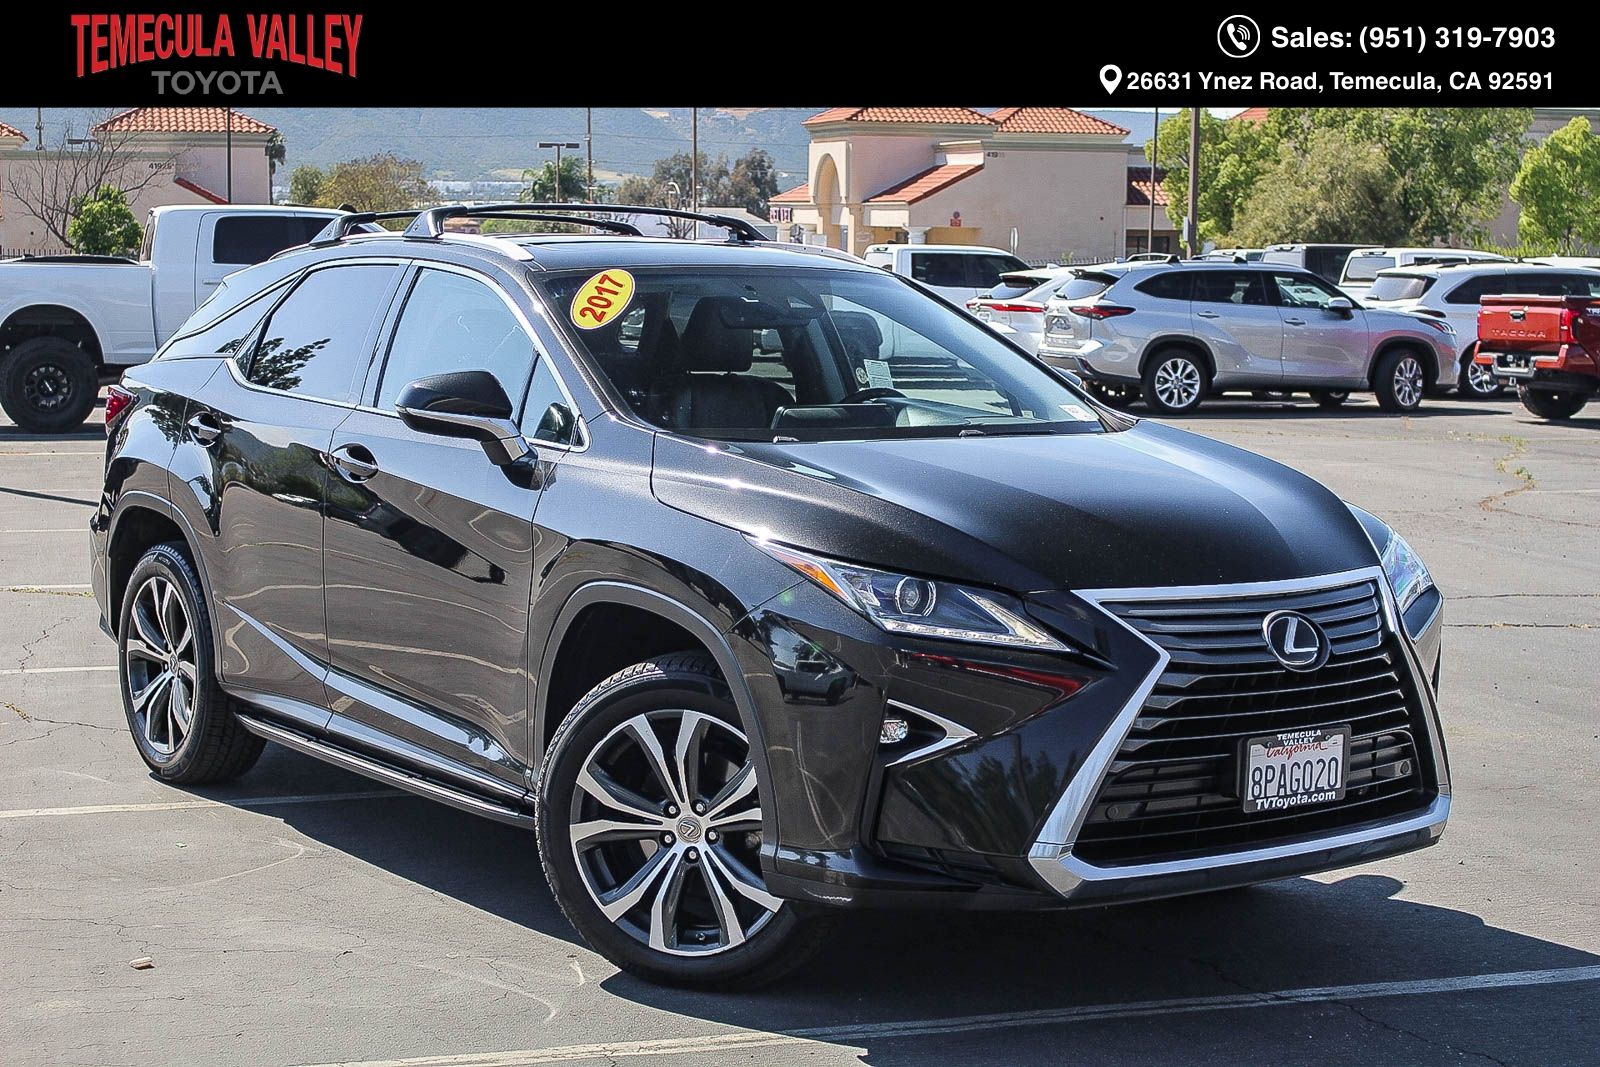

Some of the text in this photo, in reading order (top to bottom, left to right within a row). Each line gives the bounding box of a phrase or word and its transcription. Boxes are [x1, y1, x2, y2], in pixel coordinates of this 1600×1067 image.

[580, 274, 623, 323] 2017
[1492, 329, 1546, 339] TACOMA
[1277, 730, 1321, 740] TEMECULA
[1284, 737, 1315, 746] VALLEY
[1266, 742, 1328, 760] California
[1252, 757, 1338, 798] 8PAG020
[1256, 791, 1336, 810] TVToyota.com
